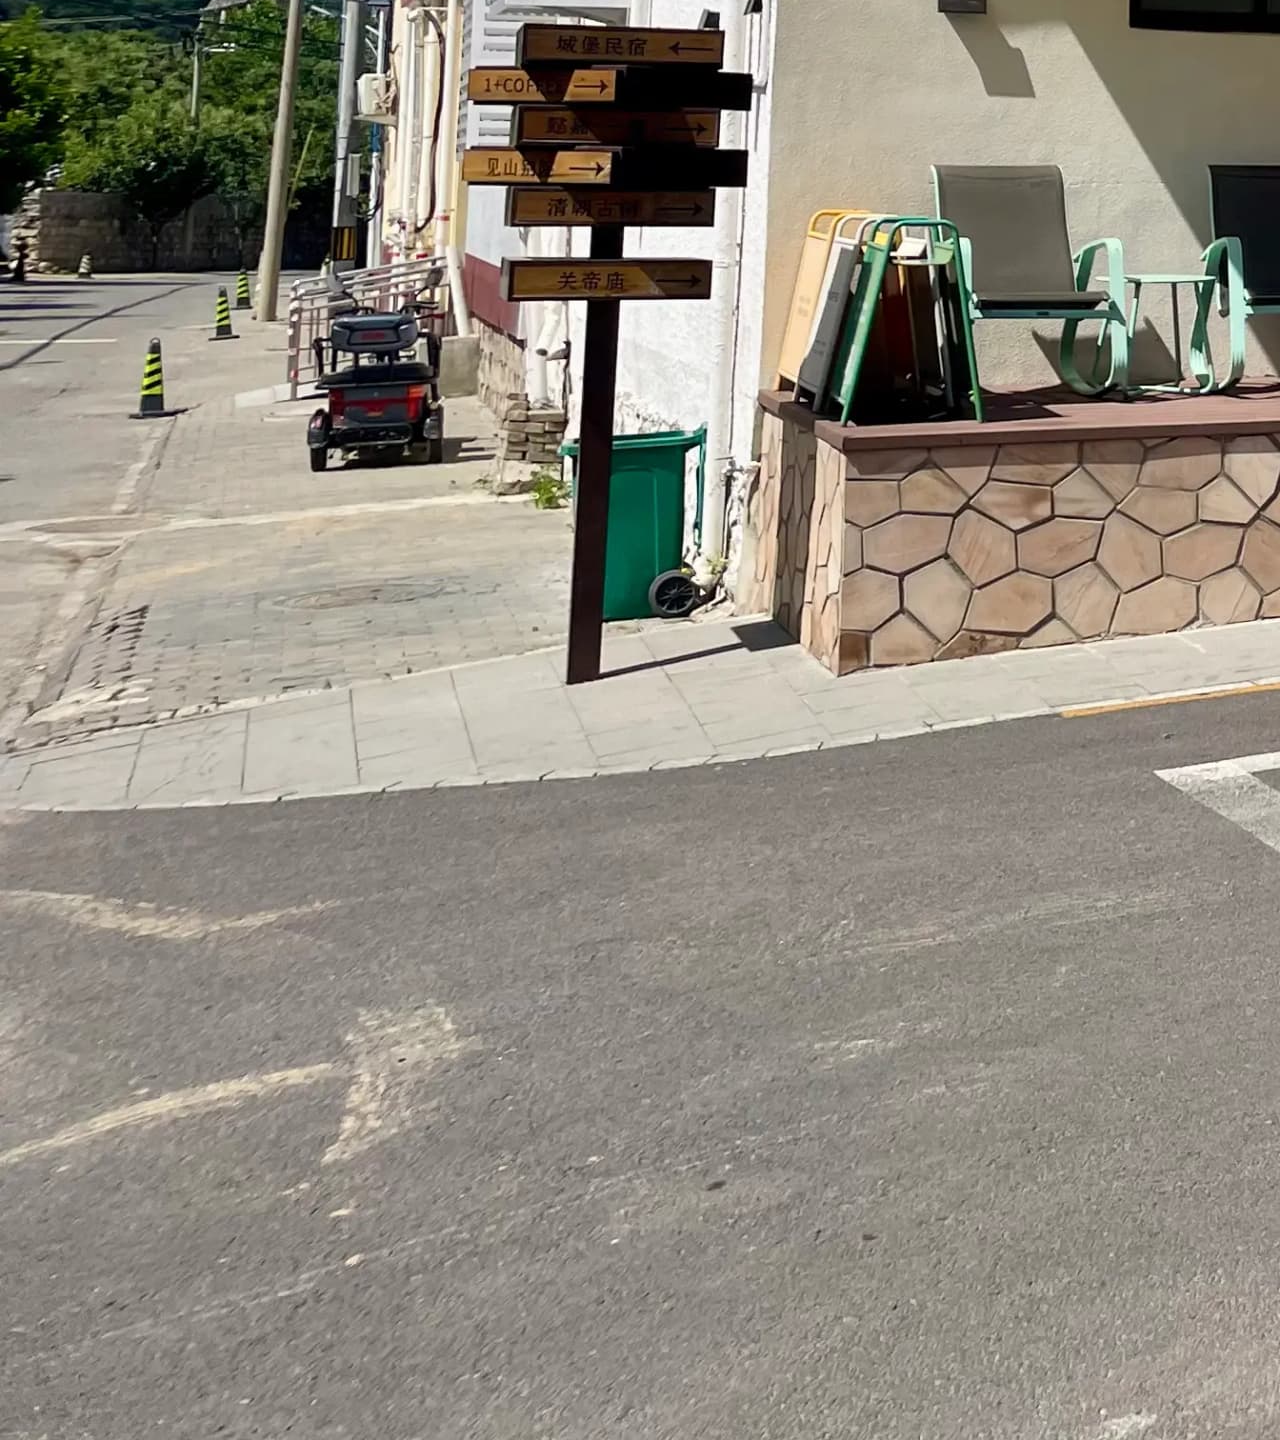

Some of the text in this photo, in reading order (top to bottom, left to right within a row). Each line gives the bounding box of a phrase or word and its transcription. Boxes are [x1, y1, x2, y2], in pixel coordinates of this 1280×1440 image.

[557, 35, 648, 57] 城堡民宿
[558, 272, 626, 292] 关帝庙
